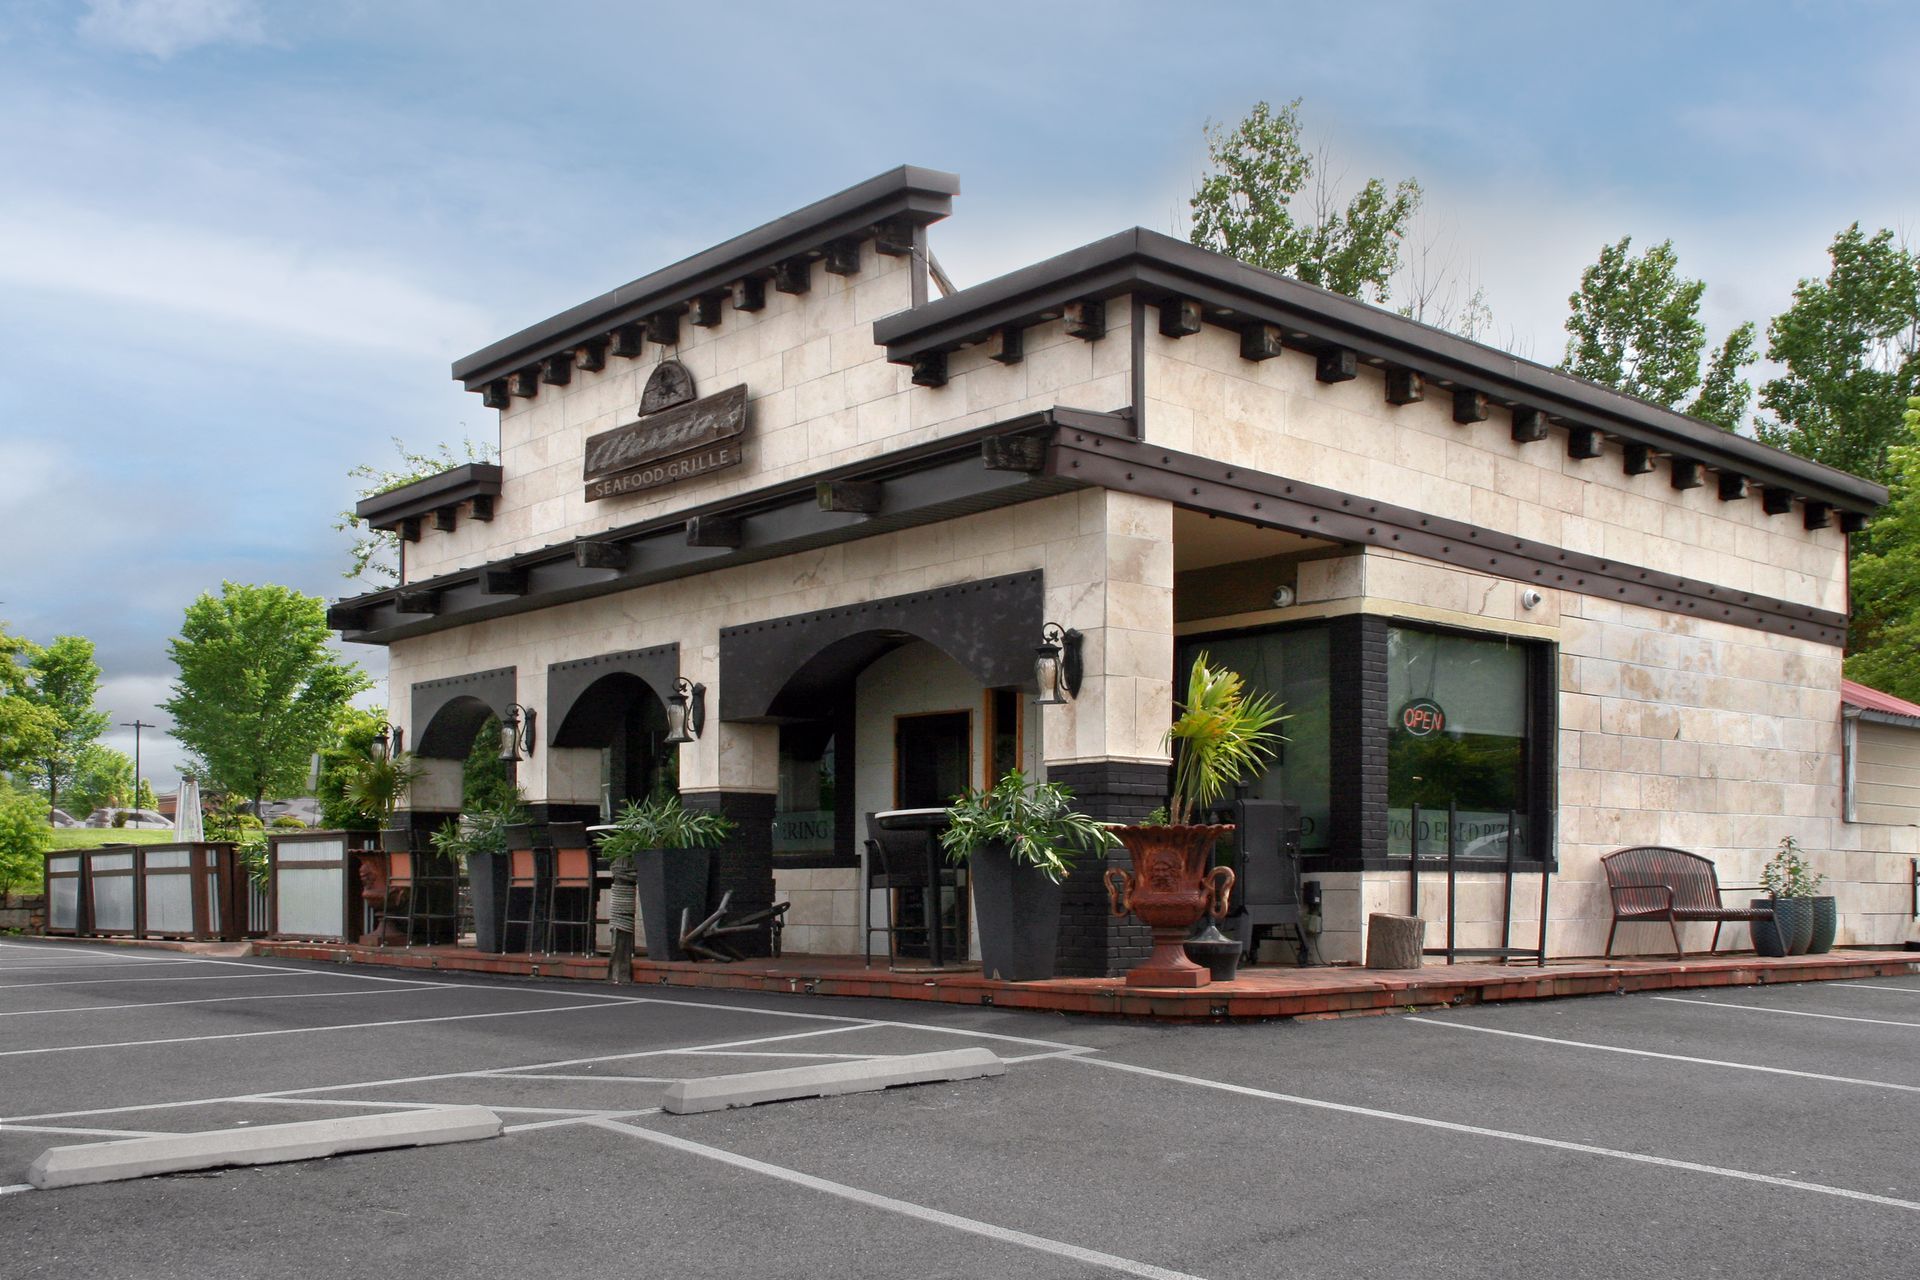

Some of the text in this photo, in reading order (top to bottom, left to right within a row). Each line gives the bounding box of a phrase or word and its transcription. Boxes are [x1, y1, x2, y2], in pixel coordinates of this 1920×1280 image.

[595, 449, 729, 498] SEAFOOD GRILLE
[1404, 708, 1443, 730] OPEN
[1388, 819, 1526, 845] OOD FIED PIZA
